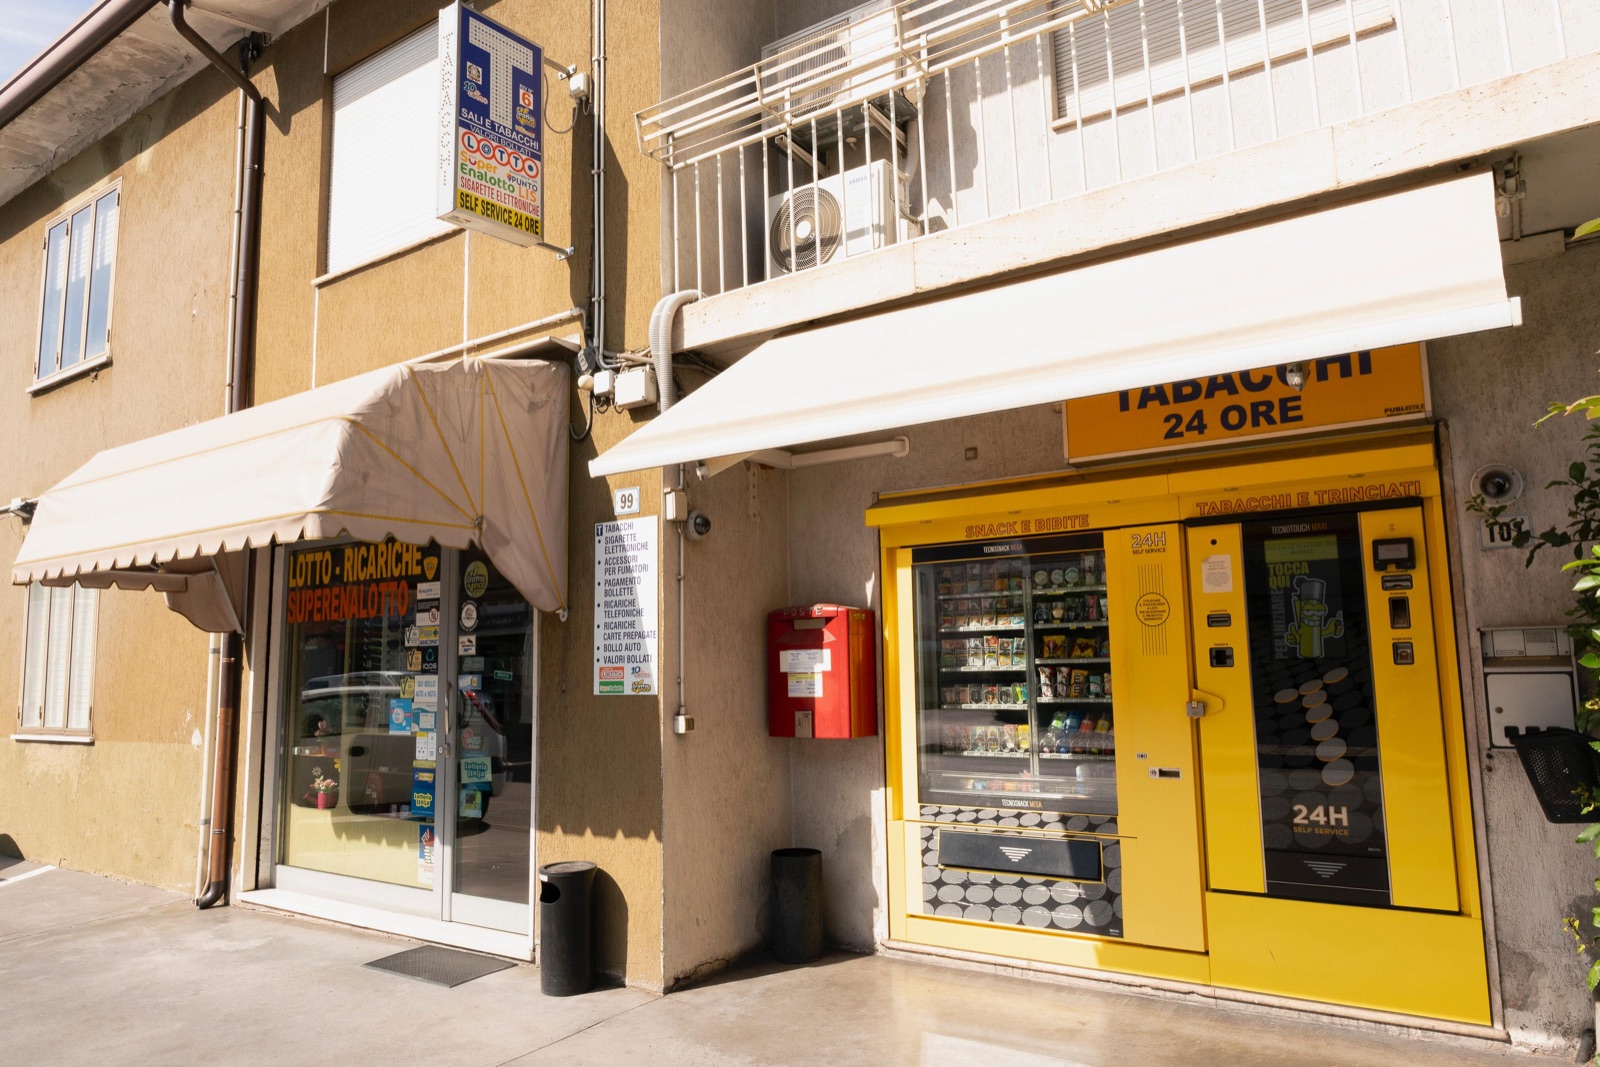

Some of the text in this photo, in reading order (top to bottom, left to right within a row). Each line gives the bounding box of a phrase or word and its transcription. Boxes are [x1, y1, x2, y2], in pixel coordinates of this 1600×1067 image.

[464, 81, 477, 92] 10
[521, 92, 532, 107] 6
[461, 108, 483, 125] SALI
[486, 119, 492, 129] E
[494, 122, 539, 150] TABACCHI
[470, 124, 499, 143] VALORI
[501, 139, 531, 157] BOLLATI
[462, 131, 539, 178] LOTTO
[461, 150, 498, 174] Super
[461, 162, 515, 193] Enalotto
[511, 176, 538, 192] PUNTO
[461, 176, 540, 217] SIGARETTE ELETTRONICHE
[518, 186, 537, 203] LIS
[460, 192, 539, 235] SELF SERVICE 24 ORE
[1164, 395, 1303, 439] 24 ORE
[620, 493, 633, 509] 99
[1197, 480, 1421, 515] TABACCHI E TRINCIATI
[605, 522, 634, 533] TABACCHI
[966, 514, 1089, 538] SNACK E BIBITE
[1271, 522, 1327, 535] TECNOTOUCH MAXI
[605, 533, 636, 545] SIGARETTE
[1132, 531, 1166, 548] 24H
[605, 542, 648, 554] ELETTRONICHE
[983, 544, 1010, 553] TECNOSNACK
[289, 551, 332, 587] LOTTO
[343, 543, 421, 582] RICARICHE
[604, 555, 638, 566] ACCESSORI
[605, 564, 648, 576] PER FUMATORI
[1268, 561, 1310, 575] TOCCA
[604, 576, 641, 587] PAGAMENTO
[1269, 575, 1290, 589] QUI
[604, 587, 633, 597] BOLLETTE
[288, 580, 409, 624] SUPERENALOTTO
[604, 598, 636, 609] RICARICHE
[604, 608, 644, 619] TELEFONICHE
[784, 607, 823, 616] POSTE
[604, 620, 636, 630] RICARICHE
[603, 630, 656, 641] CARTE PREPAGATE
[604, 642, 641, 652] BOLLO AUTO
[604, 654, 652, 664] VALORI BOLLATI
[631, 666, 641, 675] 10
[465, 762, 487, 771] Lotteria
[1001, 799, 1029, 807] TECNOSNACK
[1292, 804, 1349, 826] 24H
[1314, 827, 1349, 835] SERVICE
